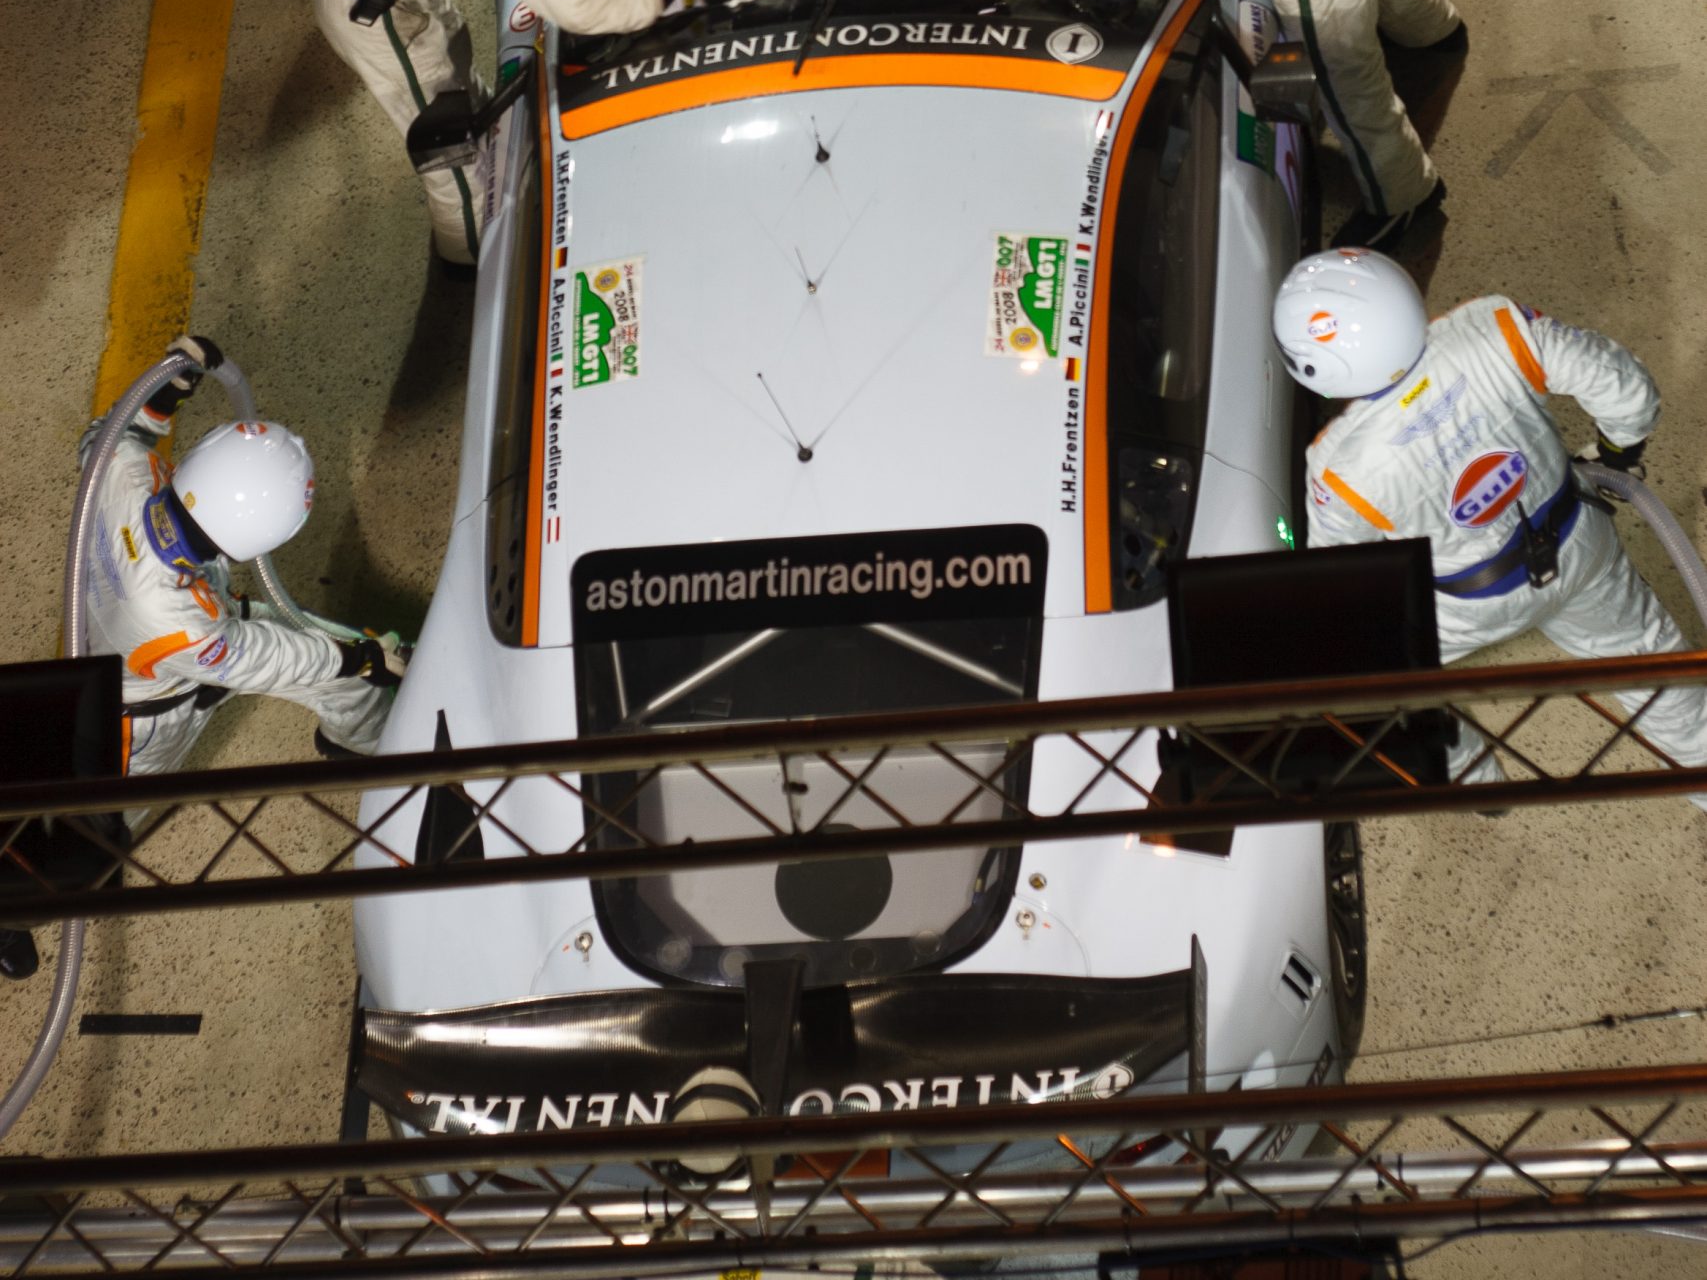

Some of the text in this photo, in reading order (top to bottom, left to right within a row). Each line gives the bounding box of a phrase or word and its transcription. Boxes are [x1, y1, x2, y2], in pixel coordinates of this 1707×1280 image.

[997, 235, 1014, 269] 007
[1033, 240, 1058, 310] LMGT1
[546, 150, 571, 511] H.H.Frentzen A.Piccini K.Wendlinger
[1002, 291, 1017, 326] 2008
[1068, 268, 1090, 347] A.Piccini
[582, 312, 600, 384] LMGT1
[622, 344, 639, 377] 007
[1061, 387, 1080, 513] H.H.Frentzen
[1454, 455, 1525, 521] Gulf
[585, 551, 1031, 612] astonmartinracing.com
